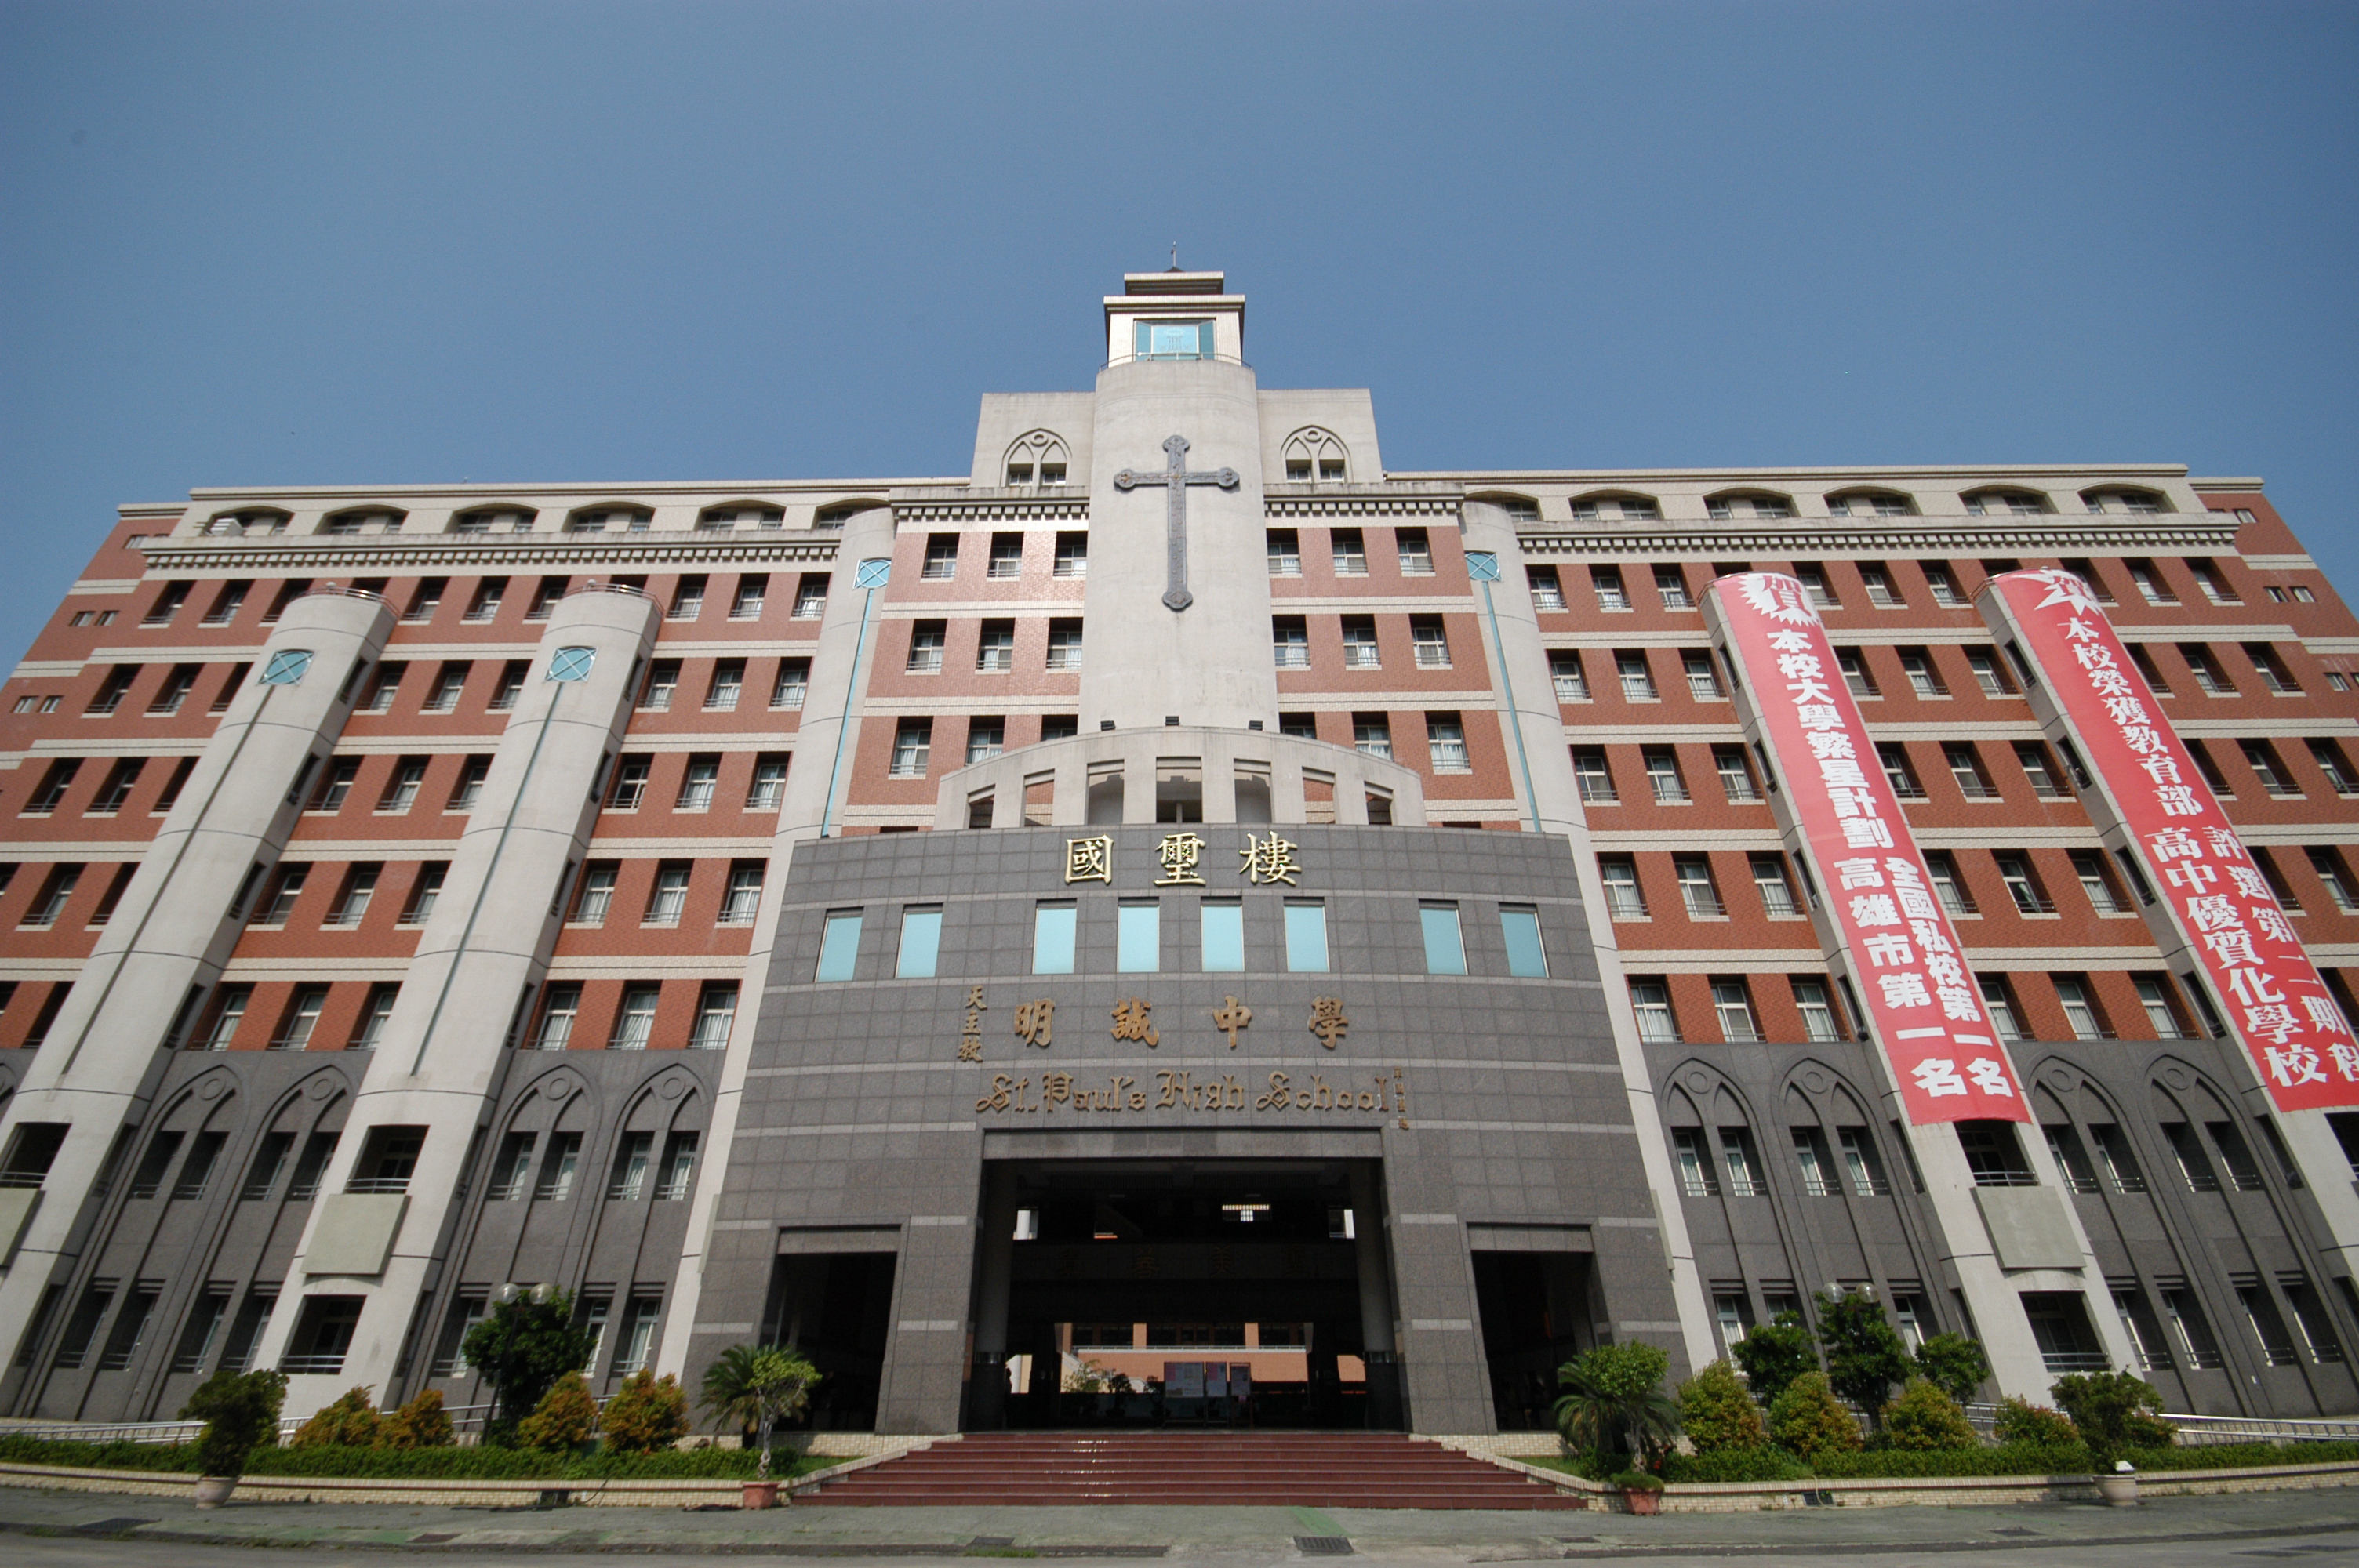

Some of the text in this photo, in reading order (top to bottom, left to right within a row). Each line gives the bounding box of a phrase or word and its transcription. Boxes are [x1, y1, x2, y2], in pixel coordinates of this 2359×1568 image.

[1759, 575, 1812, 617] 賀
[1767, 628, 1895, 849] 本校大學繁星計劃
[2057, 617, 2204, 817] 本校榮獲教育部
[1064, 831, 1302, 887] 國璽樓
[958, 985, 987, 1062] 天主教
[1014, 995, 1349, 1049] 明誠中學
[1833, 857, 1968, 1098] 高雄市第一名
[1884, 857, 2014, 1098] 全國私校第一名
[2144, 826, 2328, 1087] 高中優質化學校
[976, 1073, 1038, 1113] St.
[1042, 1070, 1147, 1113] Paul's
[1155, 1069, 1245, 1112] High
[1256, 1070, 1389, 1112] School
